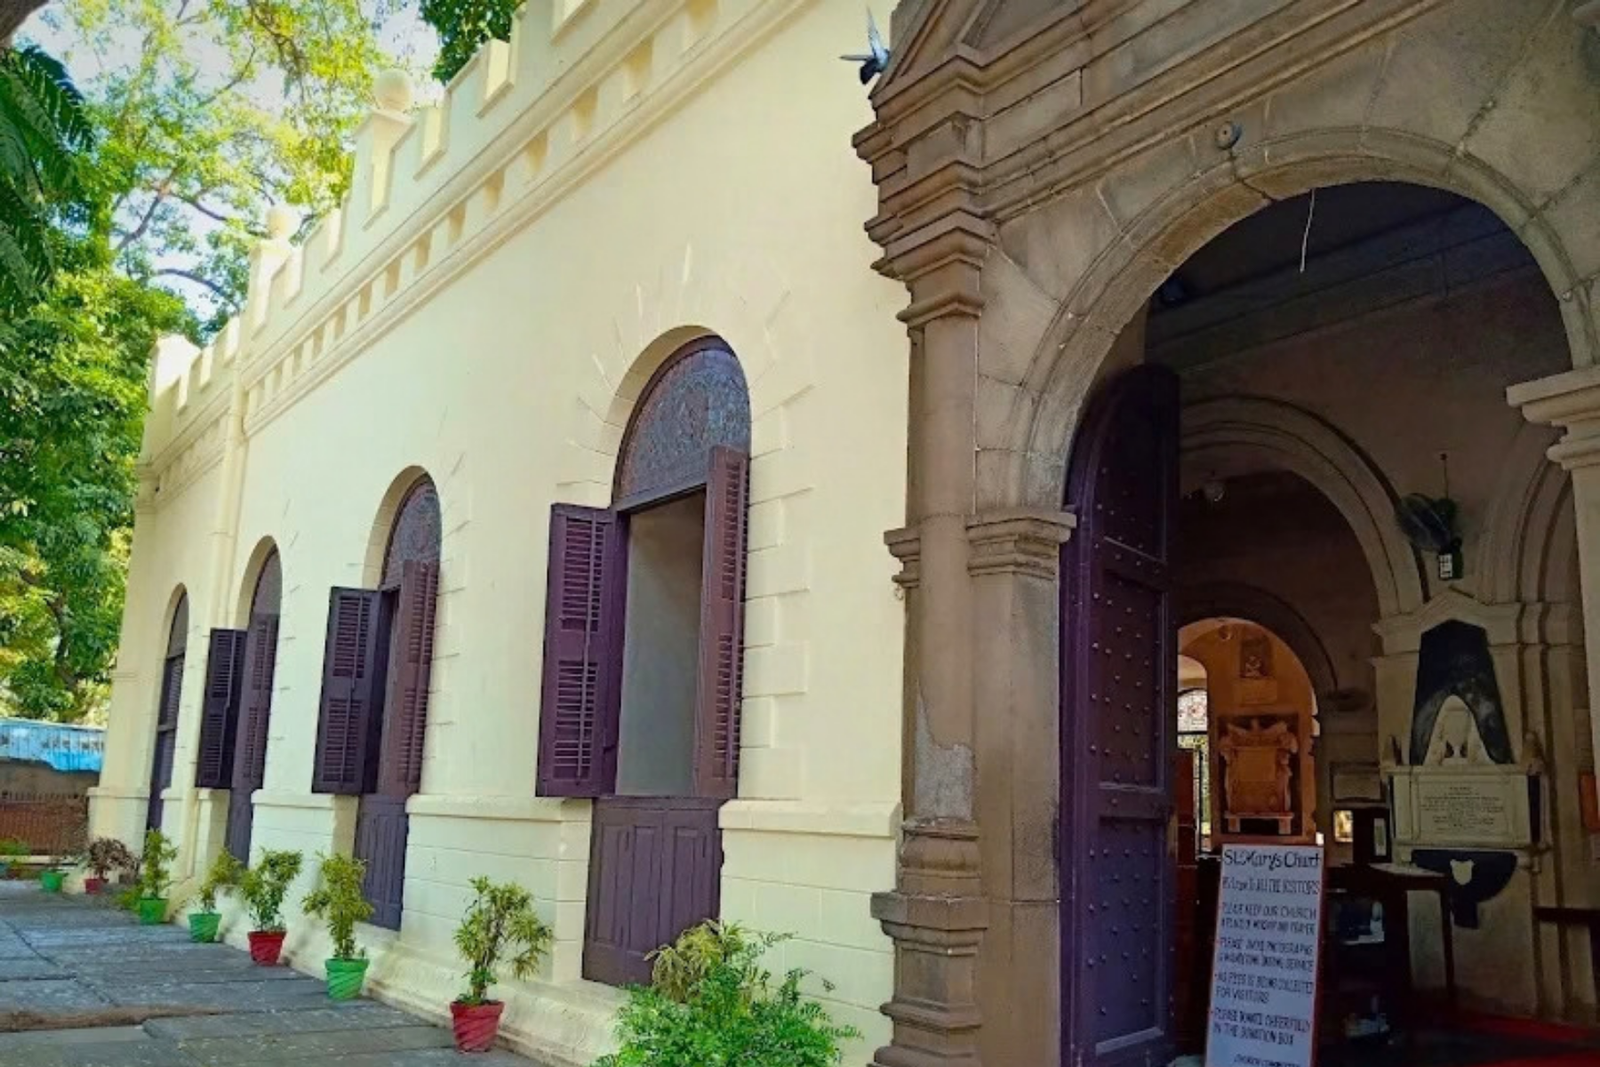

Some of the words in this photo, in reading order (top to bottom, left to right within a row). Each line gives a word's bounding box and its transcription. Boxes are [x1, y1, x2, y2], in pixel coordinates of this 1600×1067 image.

[1263, 905, 1278, 917] OUR
[1281, 905, 1316, 920] CHURCH
[1216, 986, 1230, 998] FOR
[1224, 1023, 1239, 1037] THE
[1278, 1032, 1294, 1046] BOX
